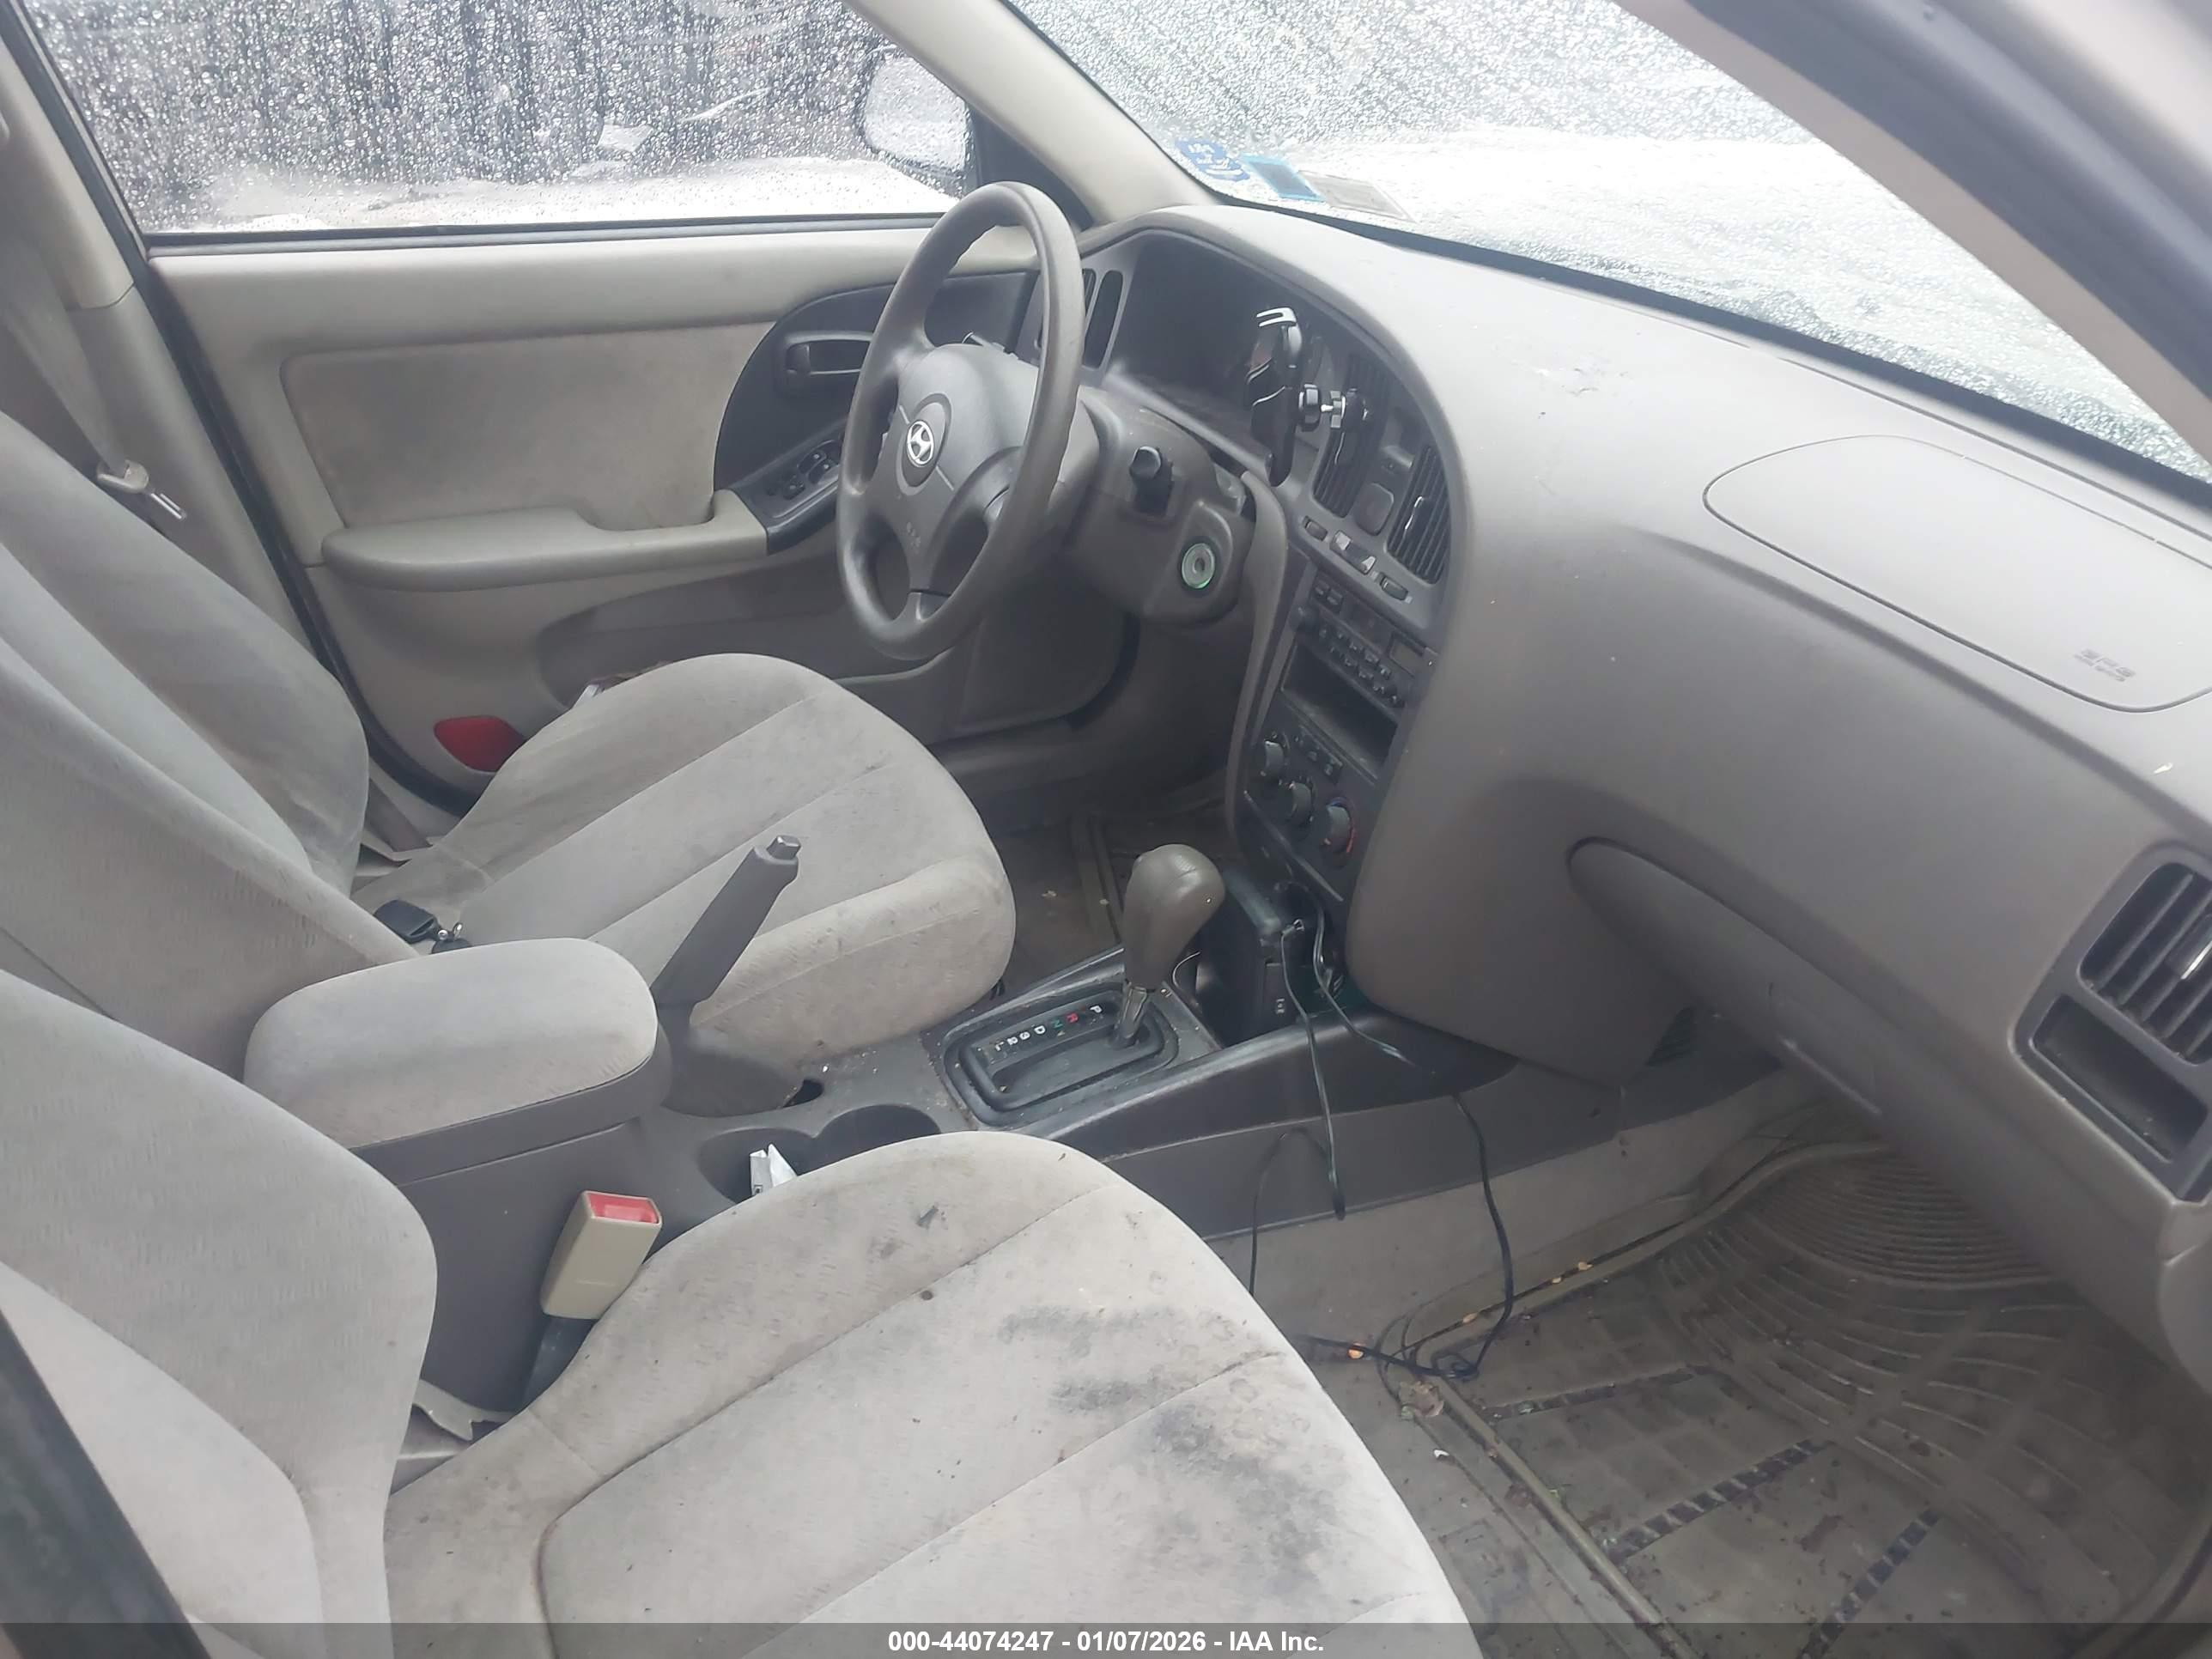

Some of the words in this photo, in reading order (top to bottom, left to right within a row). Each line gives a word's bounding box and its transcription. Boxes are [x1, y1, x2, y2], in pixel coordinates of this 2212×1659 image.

[1090, 1005, 1103, 1013] P
[1066, 1012, 1079, 1023] R
[1033, 1025, 1046, 1035] D
[994, 1041, 1005, 1052] L
